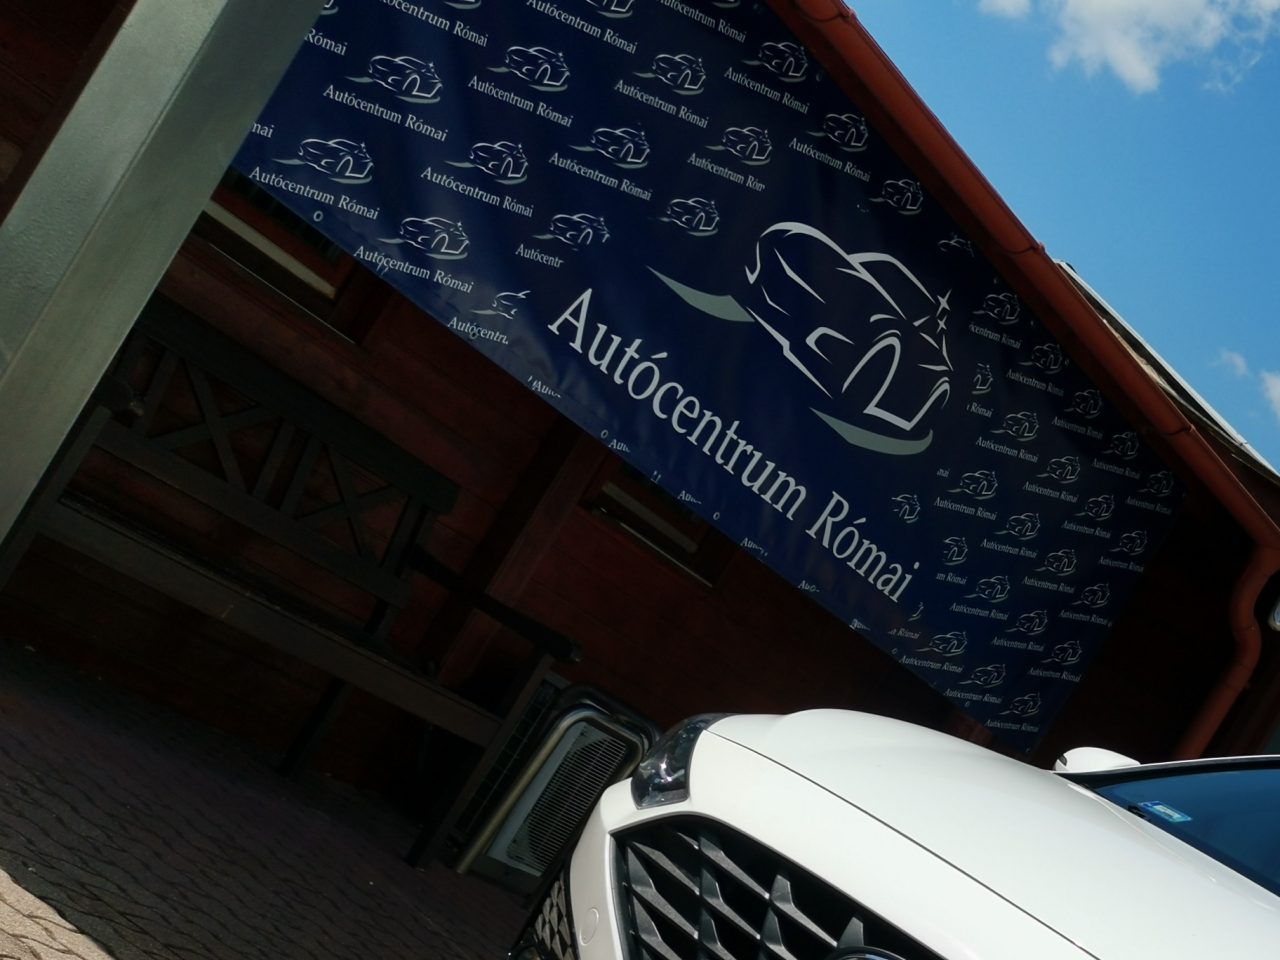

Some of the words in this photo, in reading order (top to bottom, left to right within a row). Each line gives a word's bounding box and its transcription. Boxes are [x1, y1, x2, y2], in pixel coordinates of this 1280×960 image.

[453, 20, 488, 47] Római
[603, 28, 637, 54] Római
[717, 18, 746, 44] Római
[323, 84, 401, 124] Autócentrum
[404, 114, 448, 142] Római
[468, 75, 534, 112] Autócentrum
[535, 102, 574, 128] Római
[614, 79, 676, 116] Autócentrum
[678, 105, 709, 129] Római
[724, 66, 780, 101] Autócentrum
[782, 92, 810, 115] Római
[548, 152, 619, 188] Autócentrum
[619, 179, 653, 201] Római
[687, 152, 745, 185] Autócentrum
[788, 137, 842, 169] Autócentrum
[844, 159, 871, 183] Római
[249, 165, 335, 205] Autócentrum
[338, 195, 381, 220] Római
[421, 166, 501, 208] Autócentrum
[502, 196, 533, 218] Római
[353, 245, 431, 280] Autócentrum
[433, 269, 474, 294] Római
[547, 287, 808, 520] Autócentrum
[805, 490, 921, 604] Római
